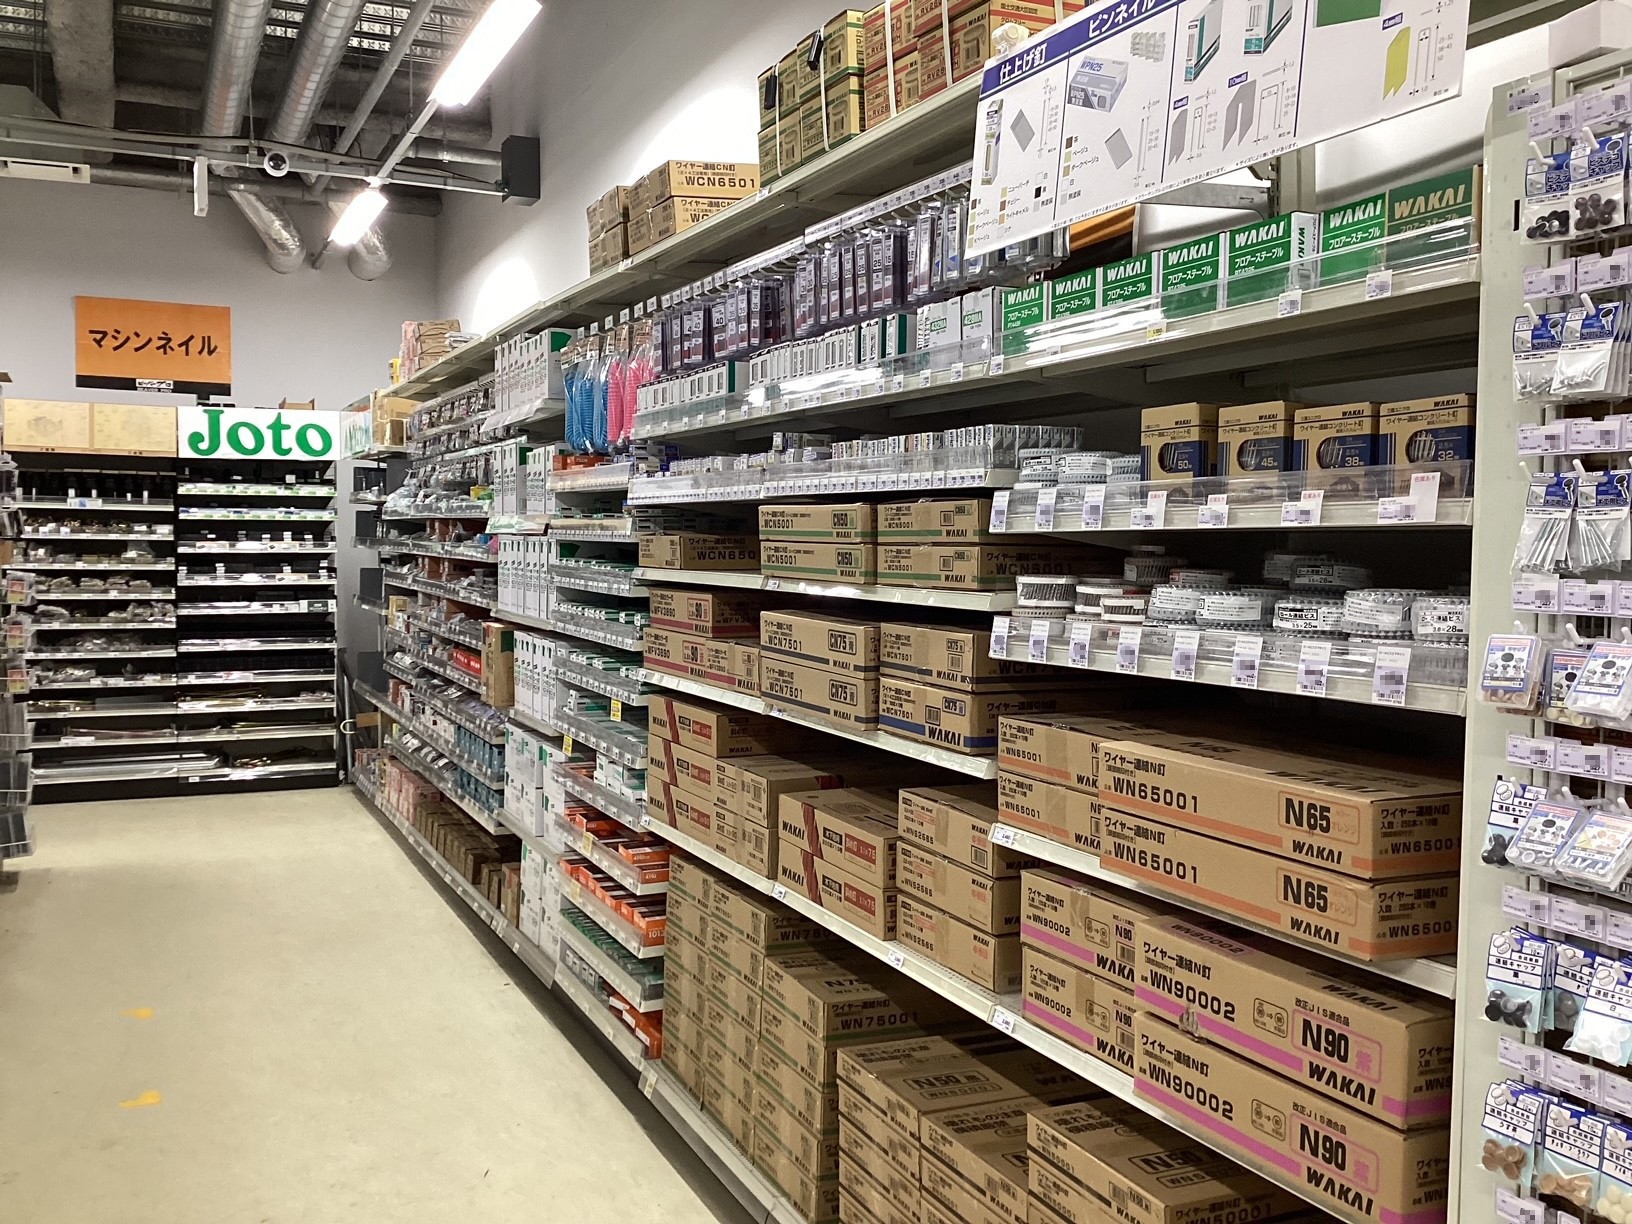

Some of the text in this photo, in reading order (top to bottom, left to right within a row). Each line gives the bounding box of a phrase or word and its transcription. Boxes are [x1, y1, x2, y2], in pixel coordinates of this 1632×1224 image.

[968, 12, 987, 27] WAKAI
[998, 43, 1048, 85] 仕上げ釘
[685, 176, 756, 189] WCN6501
[1393, 184, 1466, 221] WAKAI
[1329, 199, 1383, 230] WAKAI
[1234, 221, 1285, 249] WAKAI
[1329, 226, 1381, 251] フロアーステープル
[1168, 241, 1214, 266] WAKAI
[1234, 247, 1284, 269] フロアーステープル
[1106, 259, 1147, 283] WAKAI
[1168, 267, 1213, 285] フロアーステープル
[1054, 274, 1092, 297] WAKAI
[1106, 283, 1147, 300] フロアーステープル
[1007, 286, 1040, 306] WAKAI
[1055, 296, 1091, 314] フロアーステープル
[715, 317, 724, 326] 40
[1007, 308, 1040, 322] フロアーステープル
[88, 328, 217, 357] マシンネイル
[1341, 409, 1364, 417] WAKAI
[1433, 399, 1459, 408] WAKAI
[1258, 413, 1278, 421] WAKAI
[188, 408, 333, 457] Joto
[764, 518, 794, 529] WCN5001
[832, 512, 848, 527] CN50
[887, 521, 914, 529] WCN5001
[945, 529, 967, 538] WAKAI
[766, 554, 797, 565] WCN5001
[836, 552, 853, 566] CN50
[944, 574, 966, 583] WAKAI
[1279, 611, 1316, 620] ロール連結ビス
[1421, 615, 1462, 623] ロール連結ビス
[694, 623, 710, 634] WAKAI
[768, 635, 802, 651] WCN7501
[829, 631, 847, 650] CN75
[832, 659, 851, 671] WAKAI
[886, 651, 912, 662] WCN7501
[690, 667, 706, 678] WAKAI
[936, 670, 958, 682] WAKAI
[737, 678, 755, 691] WAKAI
[769, 682, 803, 700] WCN7501
[830, 681, 848, 701] CN75
[652, 716, 667, 728] WAKAI
[833, 709, 851, 721] WAKAI
[886, 707, 913, 719] WCN7501
[928, 726, 961, 746] WAKAI
[650, 757, 665, 770] WAKAI
[1005, 746, 1042, 763] WN65001
[1104, 752, 1166, 777] ワイヤー連結N釘
[649, 796, 665, 811] WAKAI
[1113, 776, 1198, 813] WN65001
[1004, 800, 1041, 819] WN65001
[1284, 797, 1331, 834] N65
[1381, 805, 1450, 820] ワイヤー連結N釘
[782, 820, 805, 841] WAKAI
[972, 824, 989, 835] WAKAI
[1104, 817, 1166, 845] ワイヤー連結N釘
[1292, 839, 1342, 865] WAKAI
[1113, 841, 1198, 884] WN65001
[781, 865, 804, 887] WAKAI
[971, 878, 988, 890] WAKAI
[1028, 887, 1065, 908] ワイヤー連結N釘
[1283, 874, 1329, 914] N65
[1378, 886, 1448, 905] ワイヤー連結N釘
[1032, 913, 1071, 937] WN90002
[1115, 924, 1133, 941] N90
[1290, 916, 1340, 945] WAKAI
[973, 934, 990, 947] WAKAI
[1143, 942, 1212, 980] ワイヤー連結N釘
[1495, 958, 1537, 972] 連結キャップ
[1030, 964, 1066, 988] ワイヤー連結N釘
[1034, 991, 1072, 1018] WN90002
[1150, 969, 1236, 1022] WN90002
[1321, 983, 1398, 1012] WAKAI
[1115, 1010, 1133, 1027] N90
[1301, 1018, 1349, 1064] N90
[1141, 1033, 1210, 1077] ワイヤー連結N釘
[1148, 1062, 1234, 1121] WN90002
[1308, 1060, 1376, 1106] WAKAI
[1489, 1108, 1528, 1127] 連結キャップ
[1299, 1122, 1347, 1171] N90
[1551, 1129, 1593, 1150] 連結キャップ
[1306, 1165, 1374, 1216] WAKAI
[990, 1196, 1012, 1216] WAKAI
